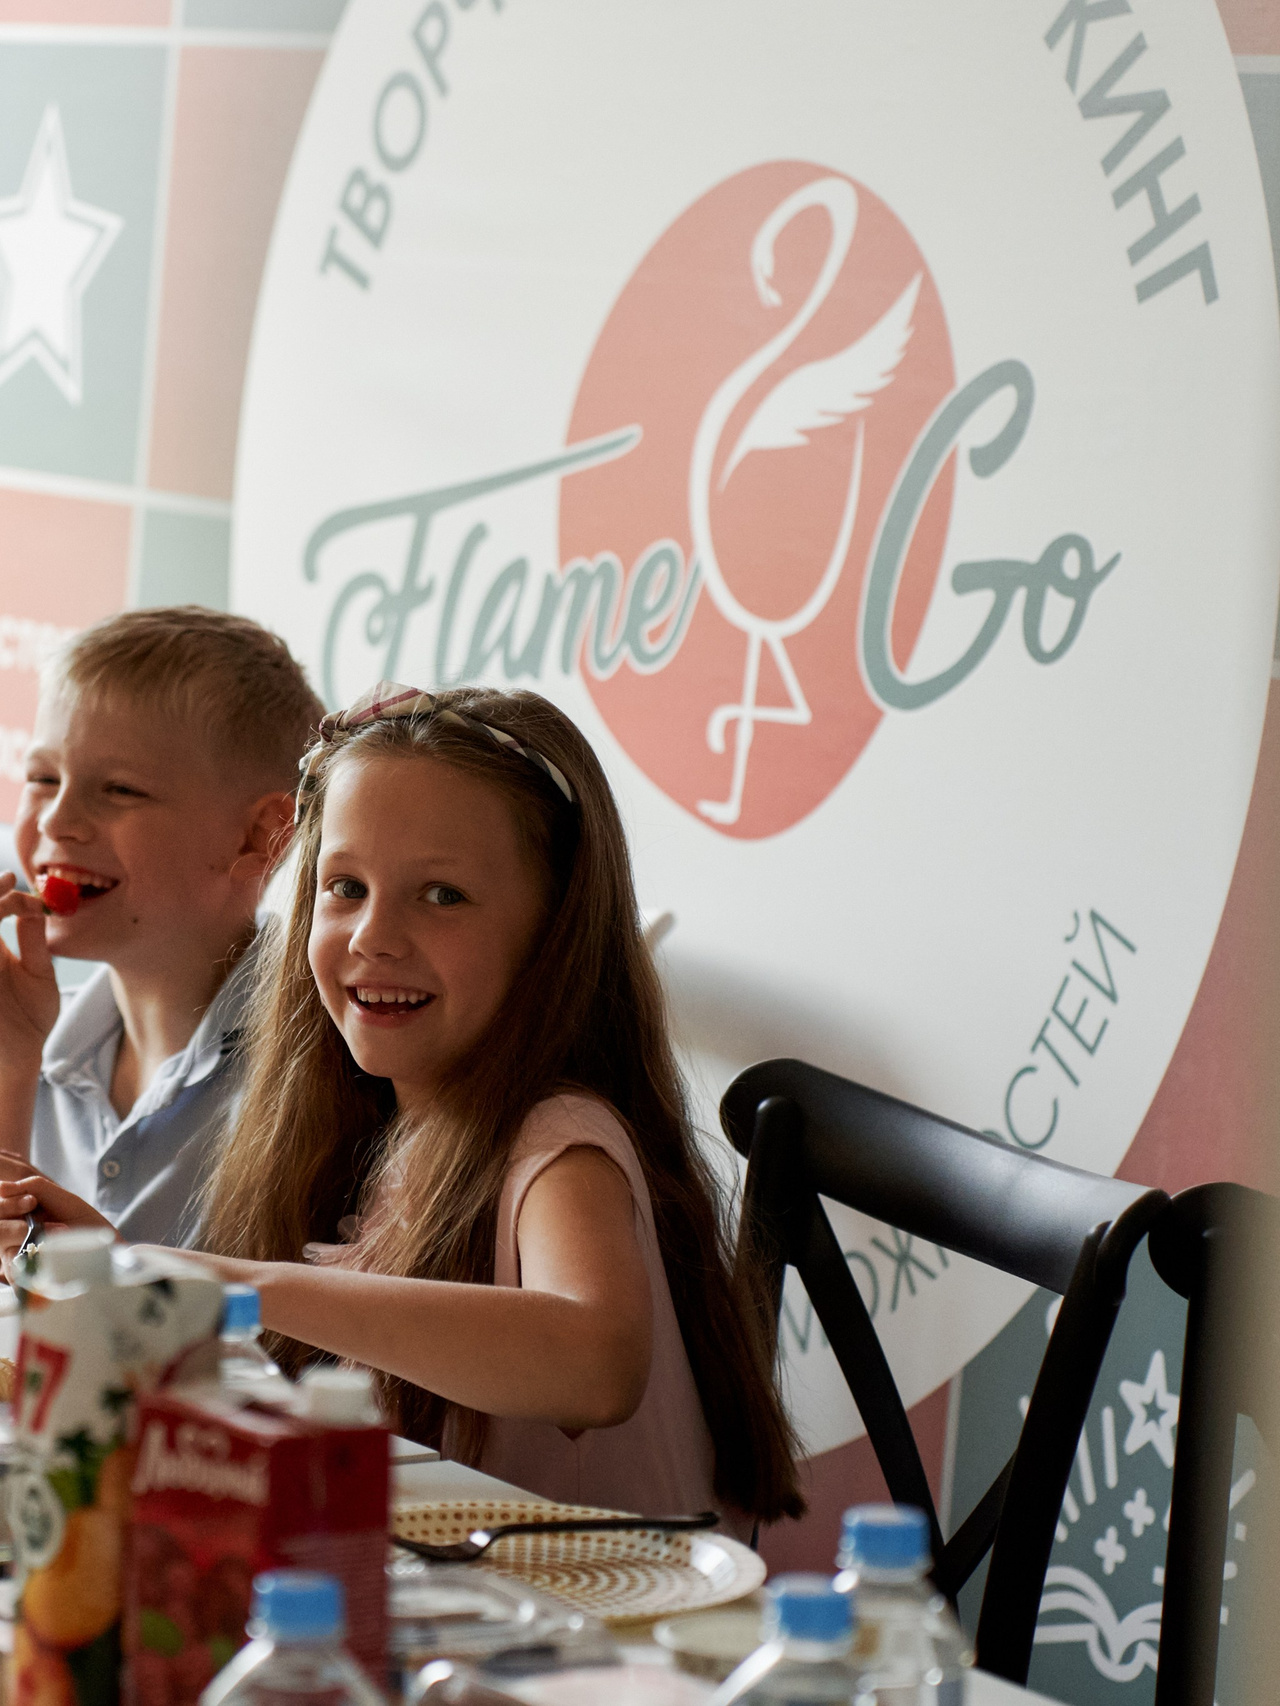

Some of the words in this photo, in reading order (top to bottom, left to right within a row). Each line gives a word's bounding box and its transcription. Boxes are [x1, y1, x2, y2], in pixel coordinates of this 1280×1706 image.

[319, 0, 503, 291] ТВОР
[1043, 0, 1219, 306] КИНГ
[303, 424, 705, 714] Flame
[862, 358, 1122, 712] Go
